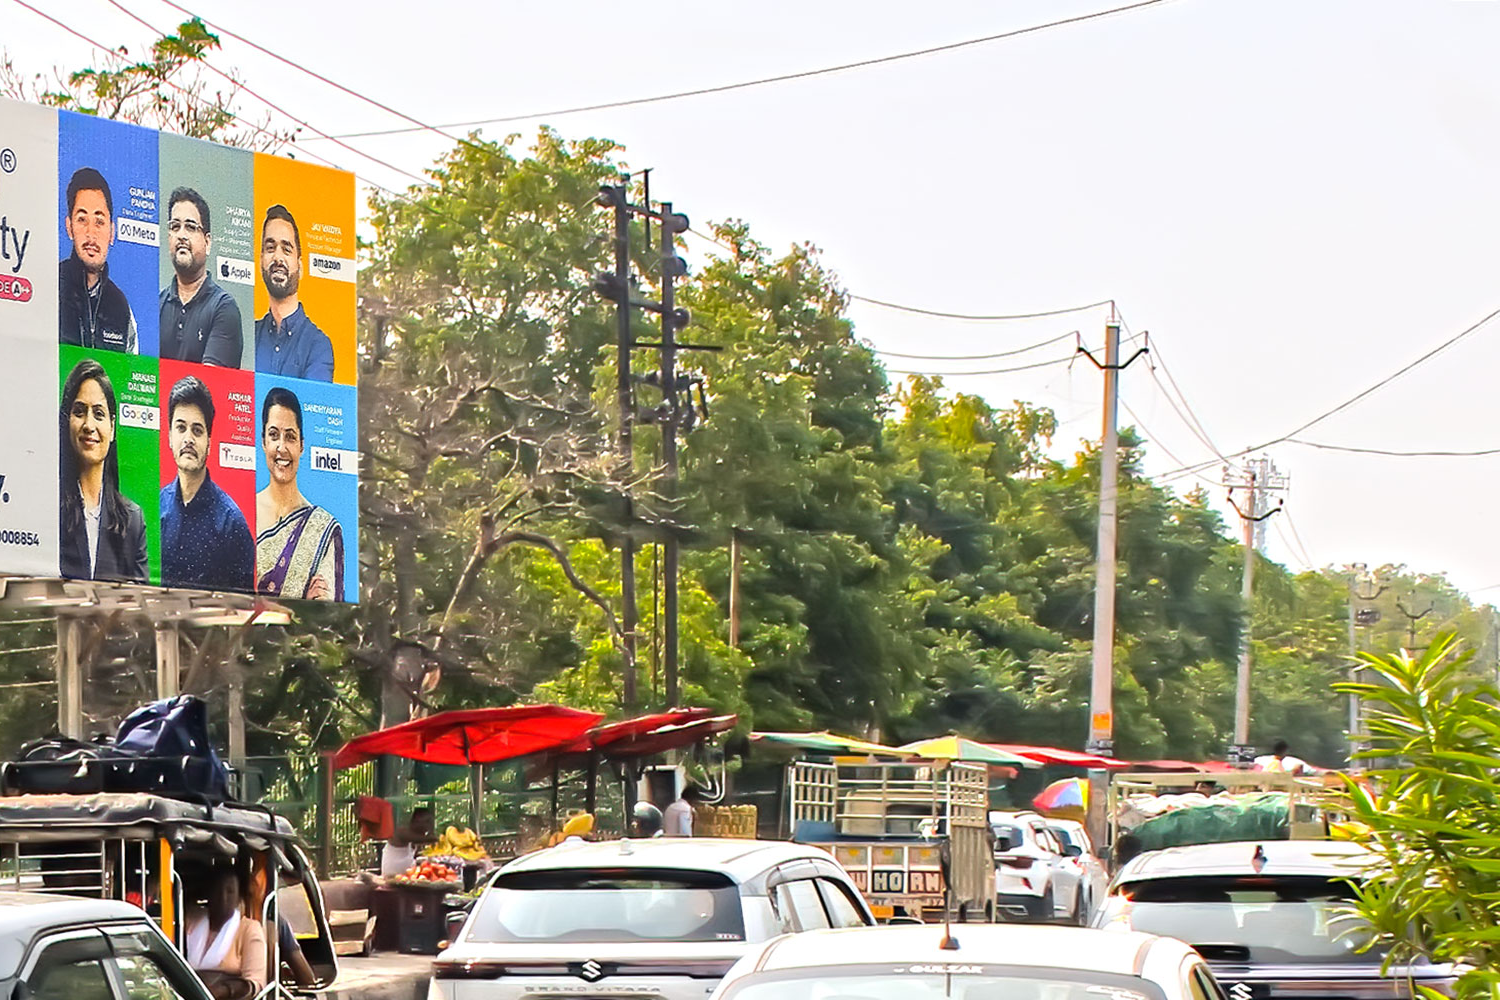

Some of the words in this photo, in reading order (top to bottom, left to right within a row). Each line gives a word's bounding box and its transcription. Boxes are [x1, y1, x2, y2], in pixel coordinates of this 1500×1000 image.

[132, 226, 156, 241] Meta
[313, 258, 341, 271] amazon
[231, 266, 252, 280] Apple
[121, 404, 154, 424] Google
